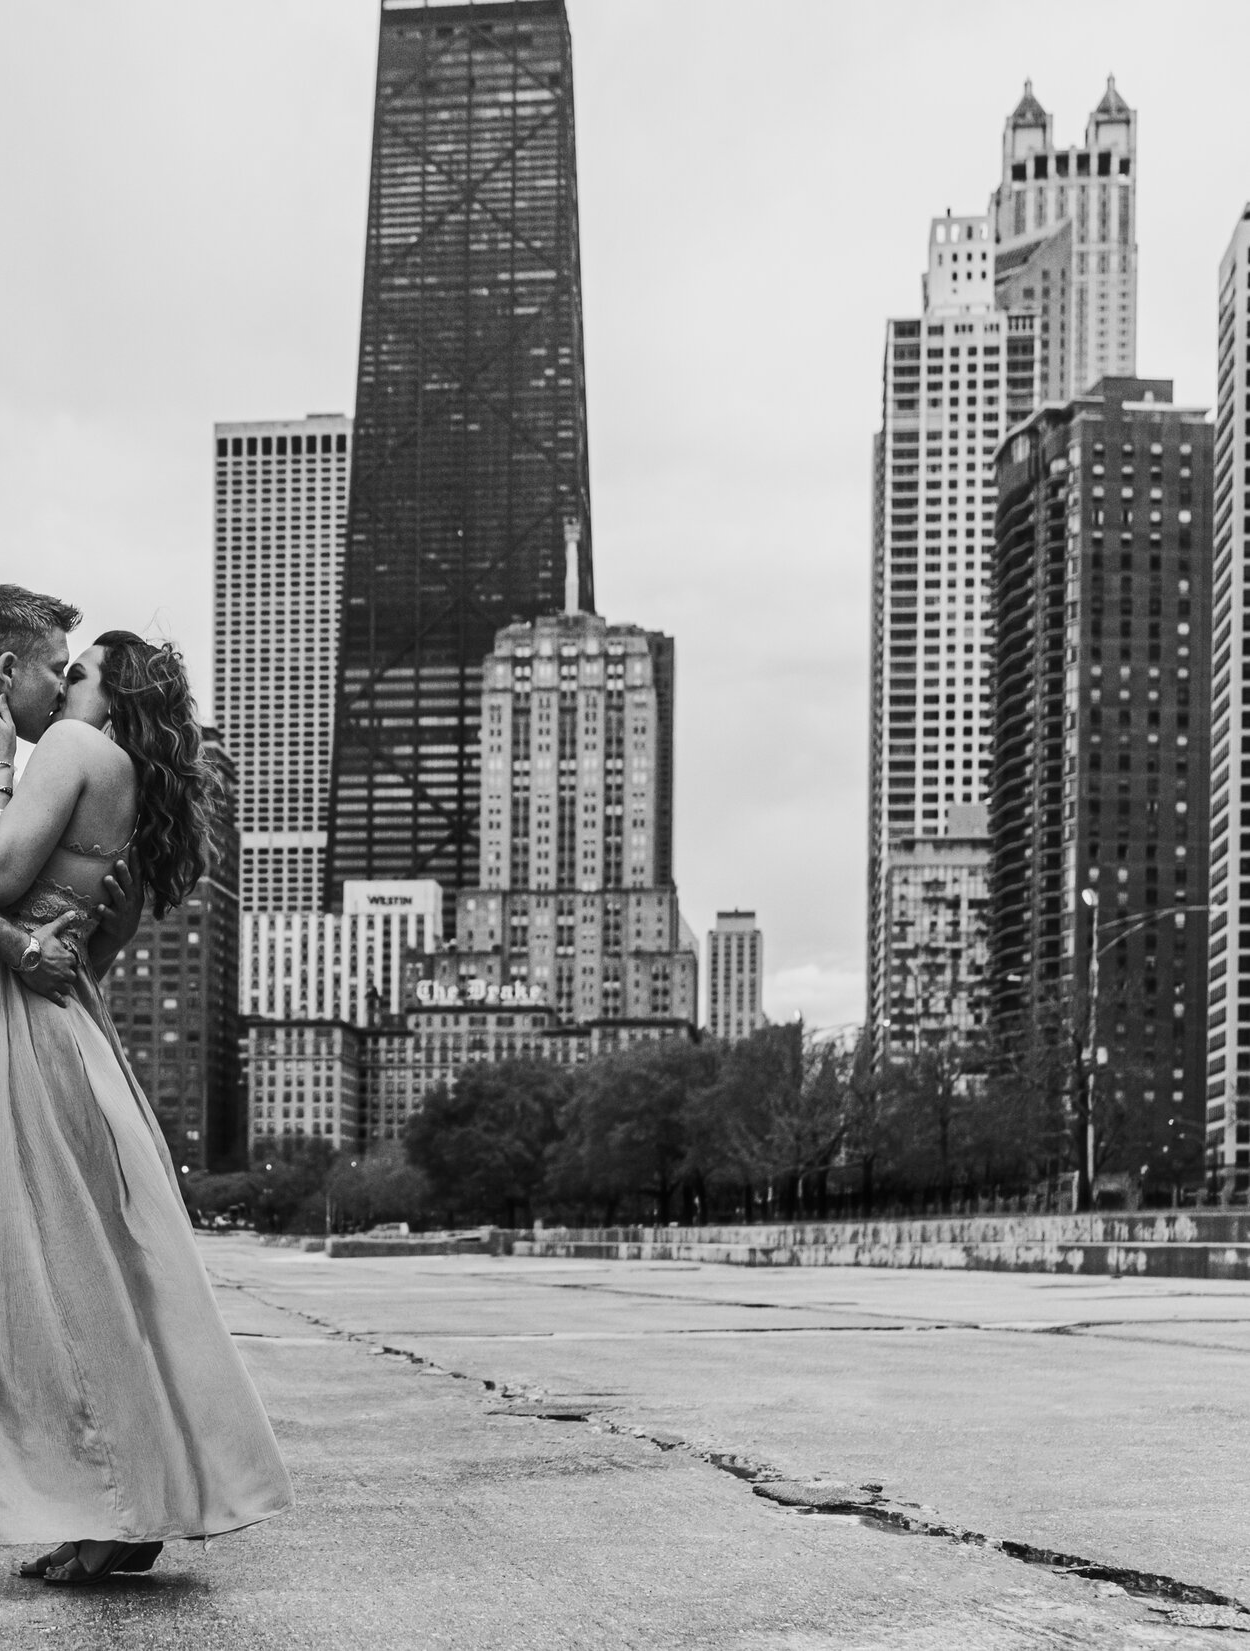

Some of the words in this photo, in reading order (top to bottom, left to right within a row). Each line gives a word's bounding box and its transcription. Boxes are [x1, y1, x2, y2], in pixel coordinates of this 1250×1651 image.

[366, 895, 413, 905] WESTIN
[416, 979, 459, 1001] The
[467, 979, 543, 1002] Drake
